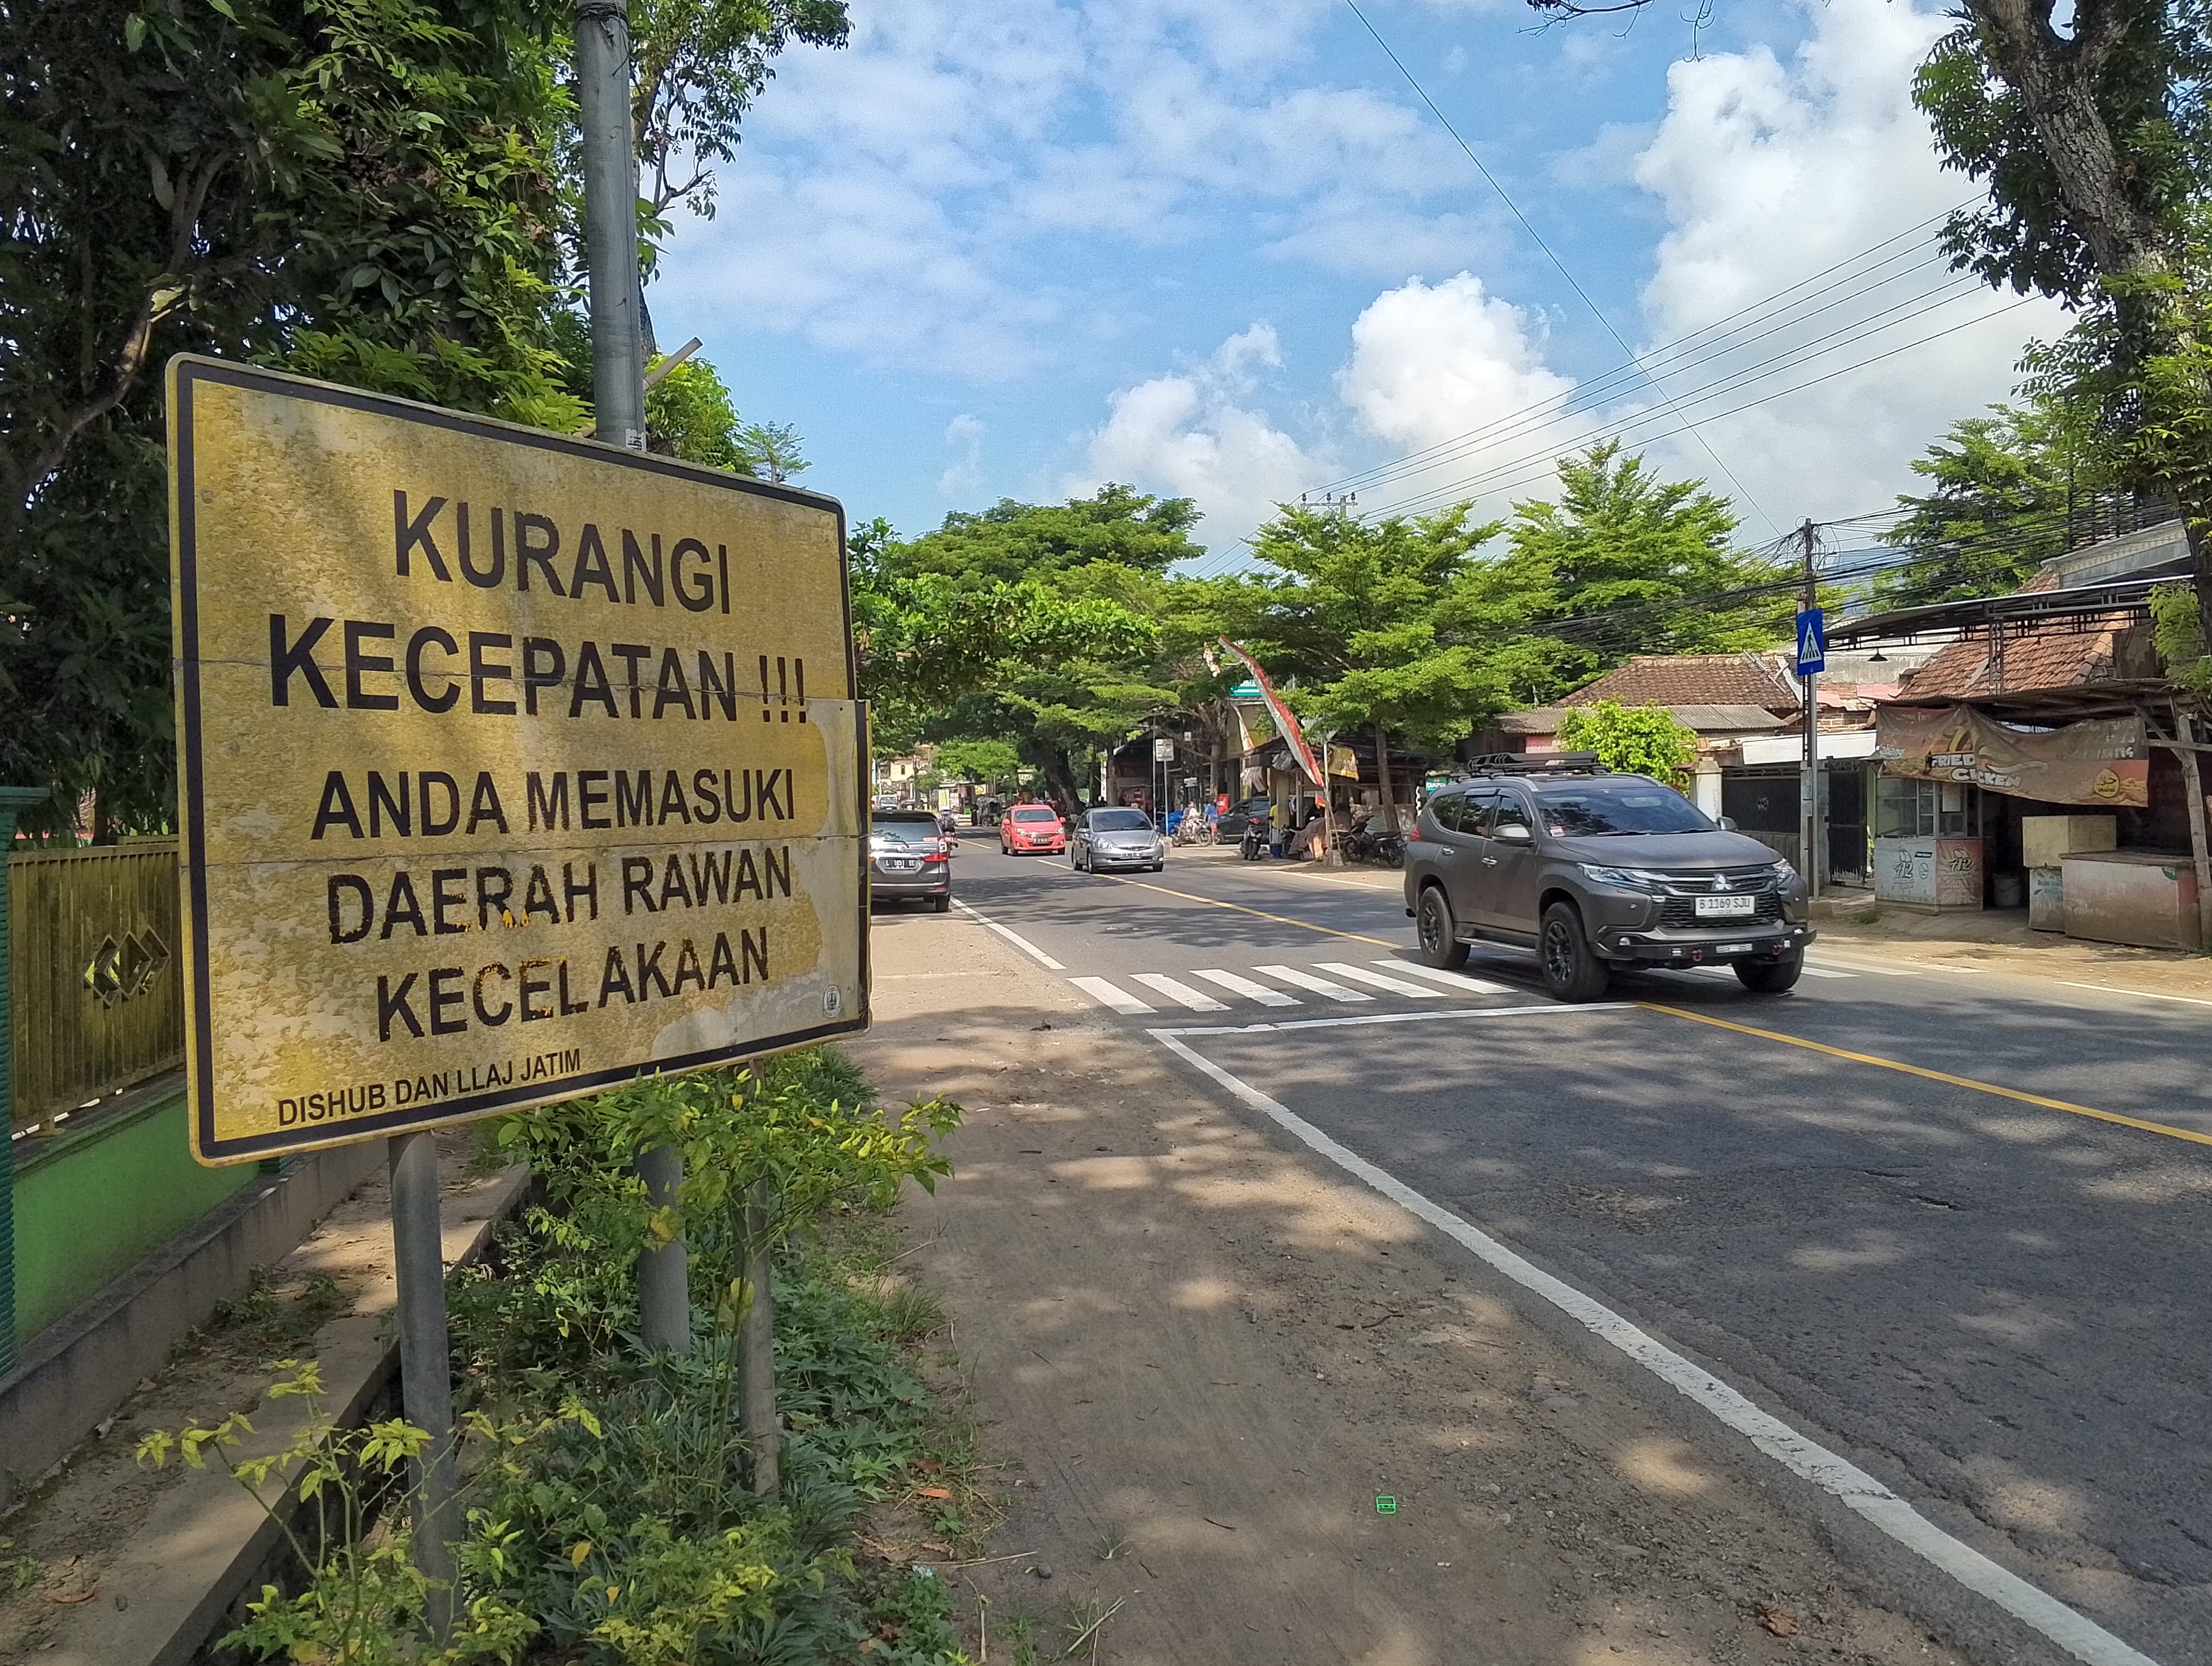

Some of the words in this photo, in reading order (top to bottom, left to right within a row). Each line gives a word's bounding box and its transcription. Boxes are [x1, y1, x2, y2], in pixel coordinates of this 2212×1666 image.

[393, 489, 730, 614] KURANGI
[268, 614, 737, 722] KECEPATAN
[759, 655, 808, 725] !!!
[311, 771, 511, 841] ANDA
[527, 767, 796, 832] MEMASUKI
[1931, 754, 1976, 767] FRIED
[327, 862, 599, 946] DAERAH
[622, 847, 791, 916] RAWAN
[1700, 899, 1705, 909] B
[1708, 898, 1731, 908] 1169
[1733, 898, 1750, 908] SJU
[377, 925, 770, 1043] KECELAKAAN
[277, 1085, 387, 1127] DISHUB
[395, 1072, 449, 1107] DAN
[456, 1061, 514, 1092] LLAJ
[520, 1048, 582, 1082] JATIM
